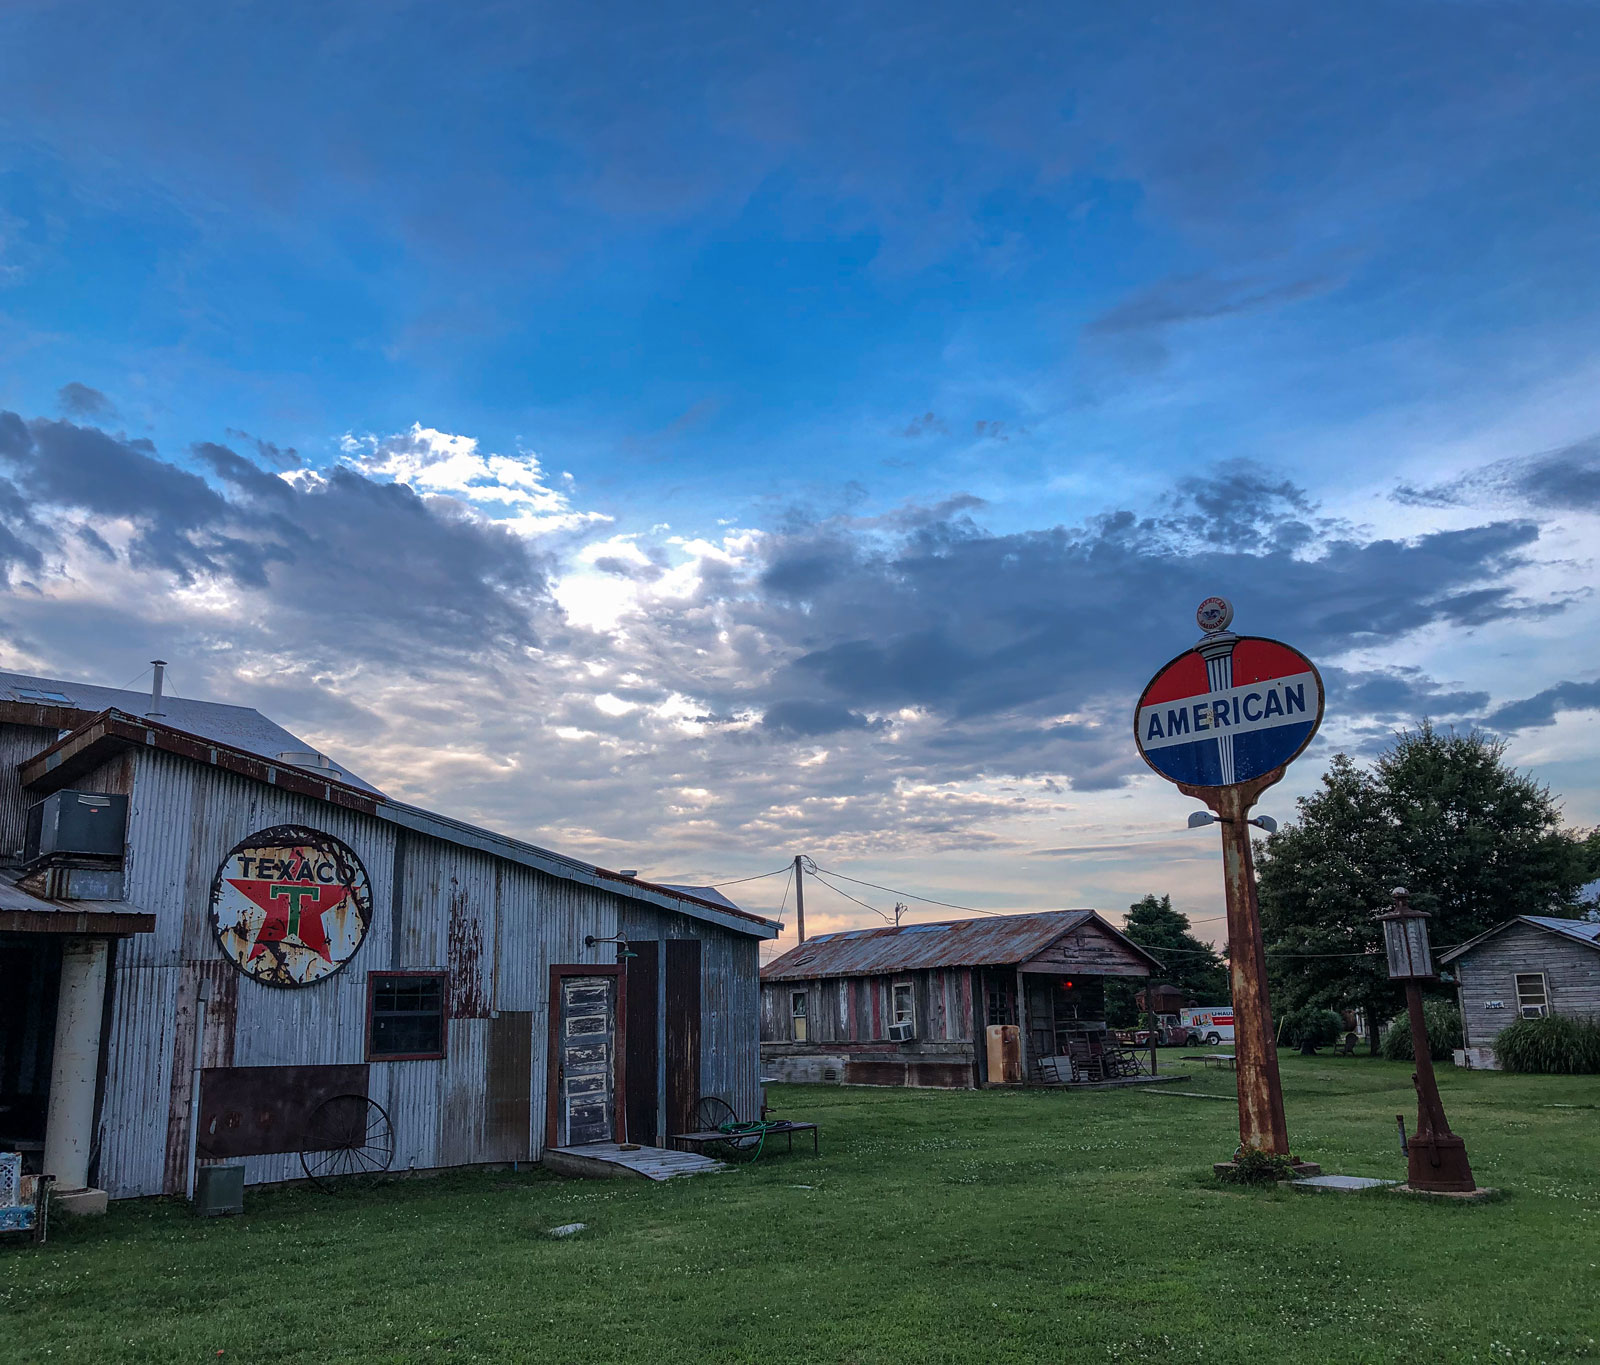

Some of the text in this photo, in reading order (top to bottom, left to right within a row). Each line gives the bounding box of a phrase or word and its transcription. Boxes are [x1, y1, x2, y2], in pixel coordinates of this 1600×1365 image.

[1147, 683, 1306, 741] AMERICAN
[237, 856, 356, 884] TEXACO
[270, 884, 320, 936] T
